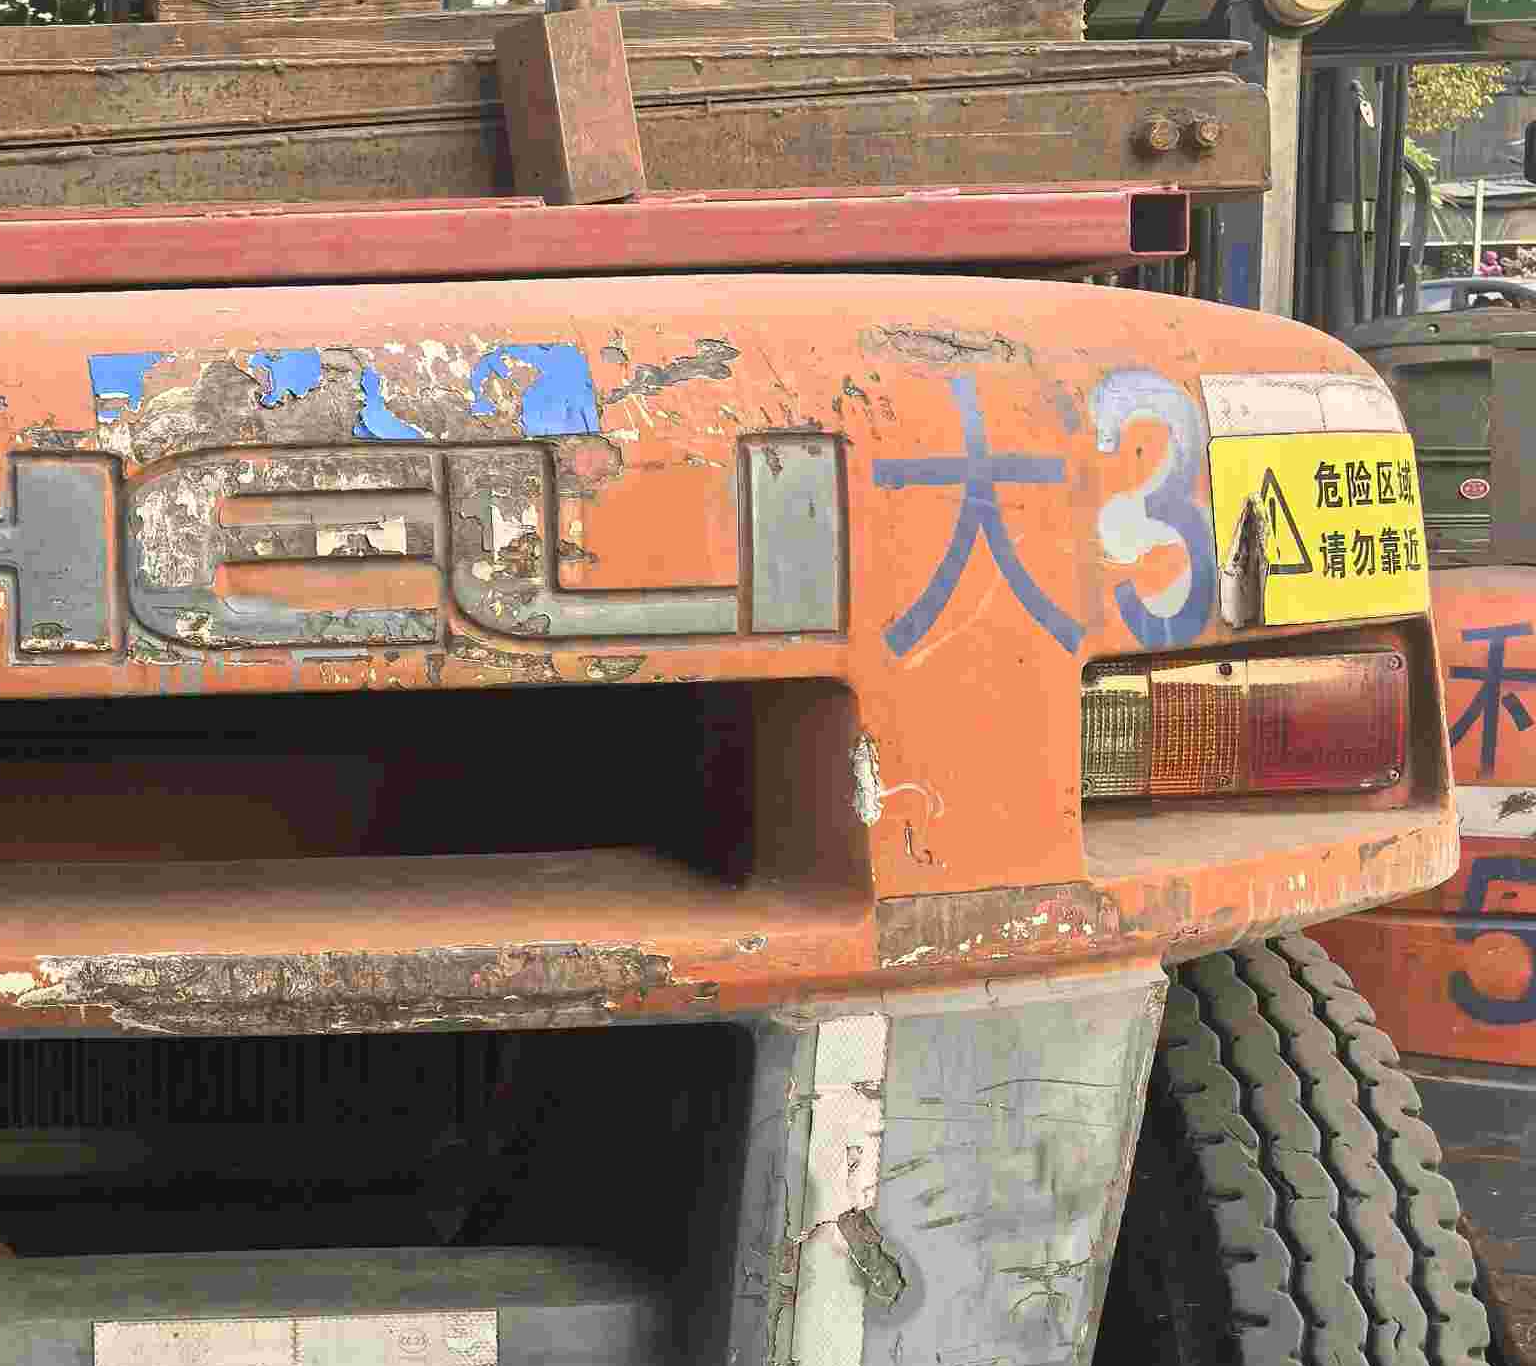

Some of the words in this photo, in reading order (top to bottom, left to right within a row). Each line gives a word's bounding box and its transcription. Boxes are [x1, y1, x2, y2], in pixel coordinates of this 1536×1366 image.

[872, 370, 1087, 657] 大
[1089, 366, 1216, 649] 3
[1313, 458, 1416, 509] 危险区域
[1319, 526, 1422, 580] 请勿靠近
